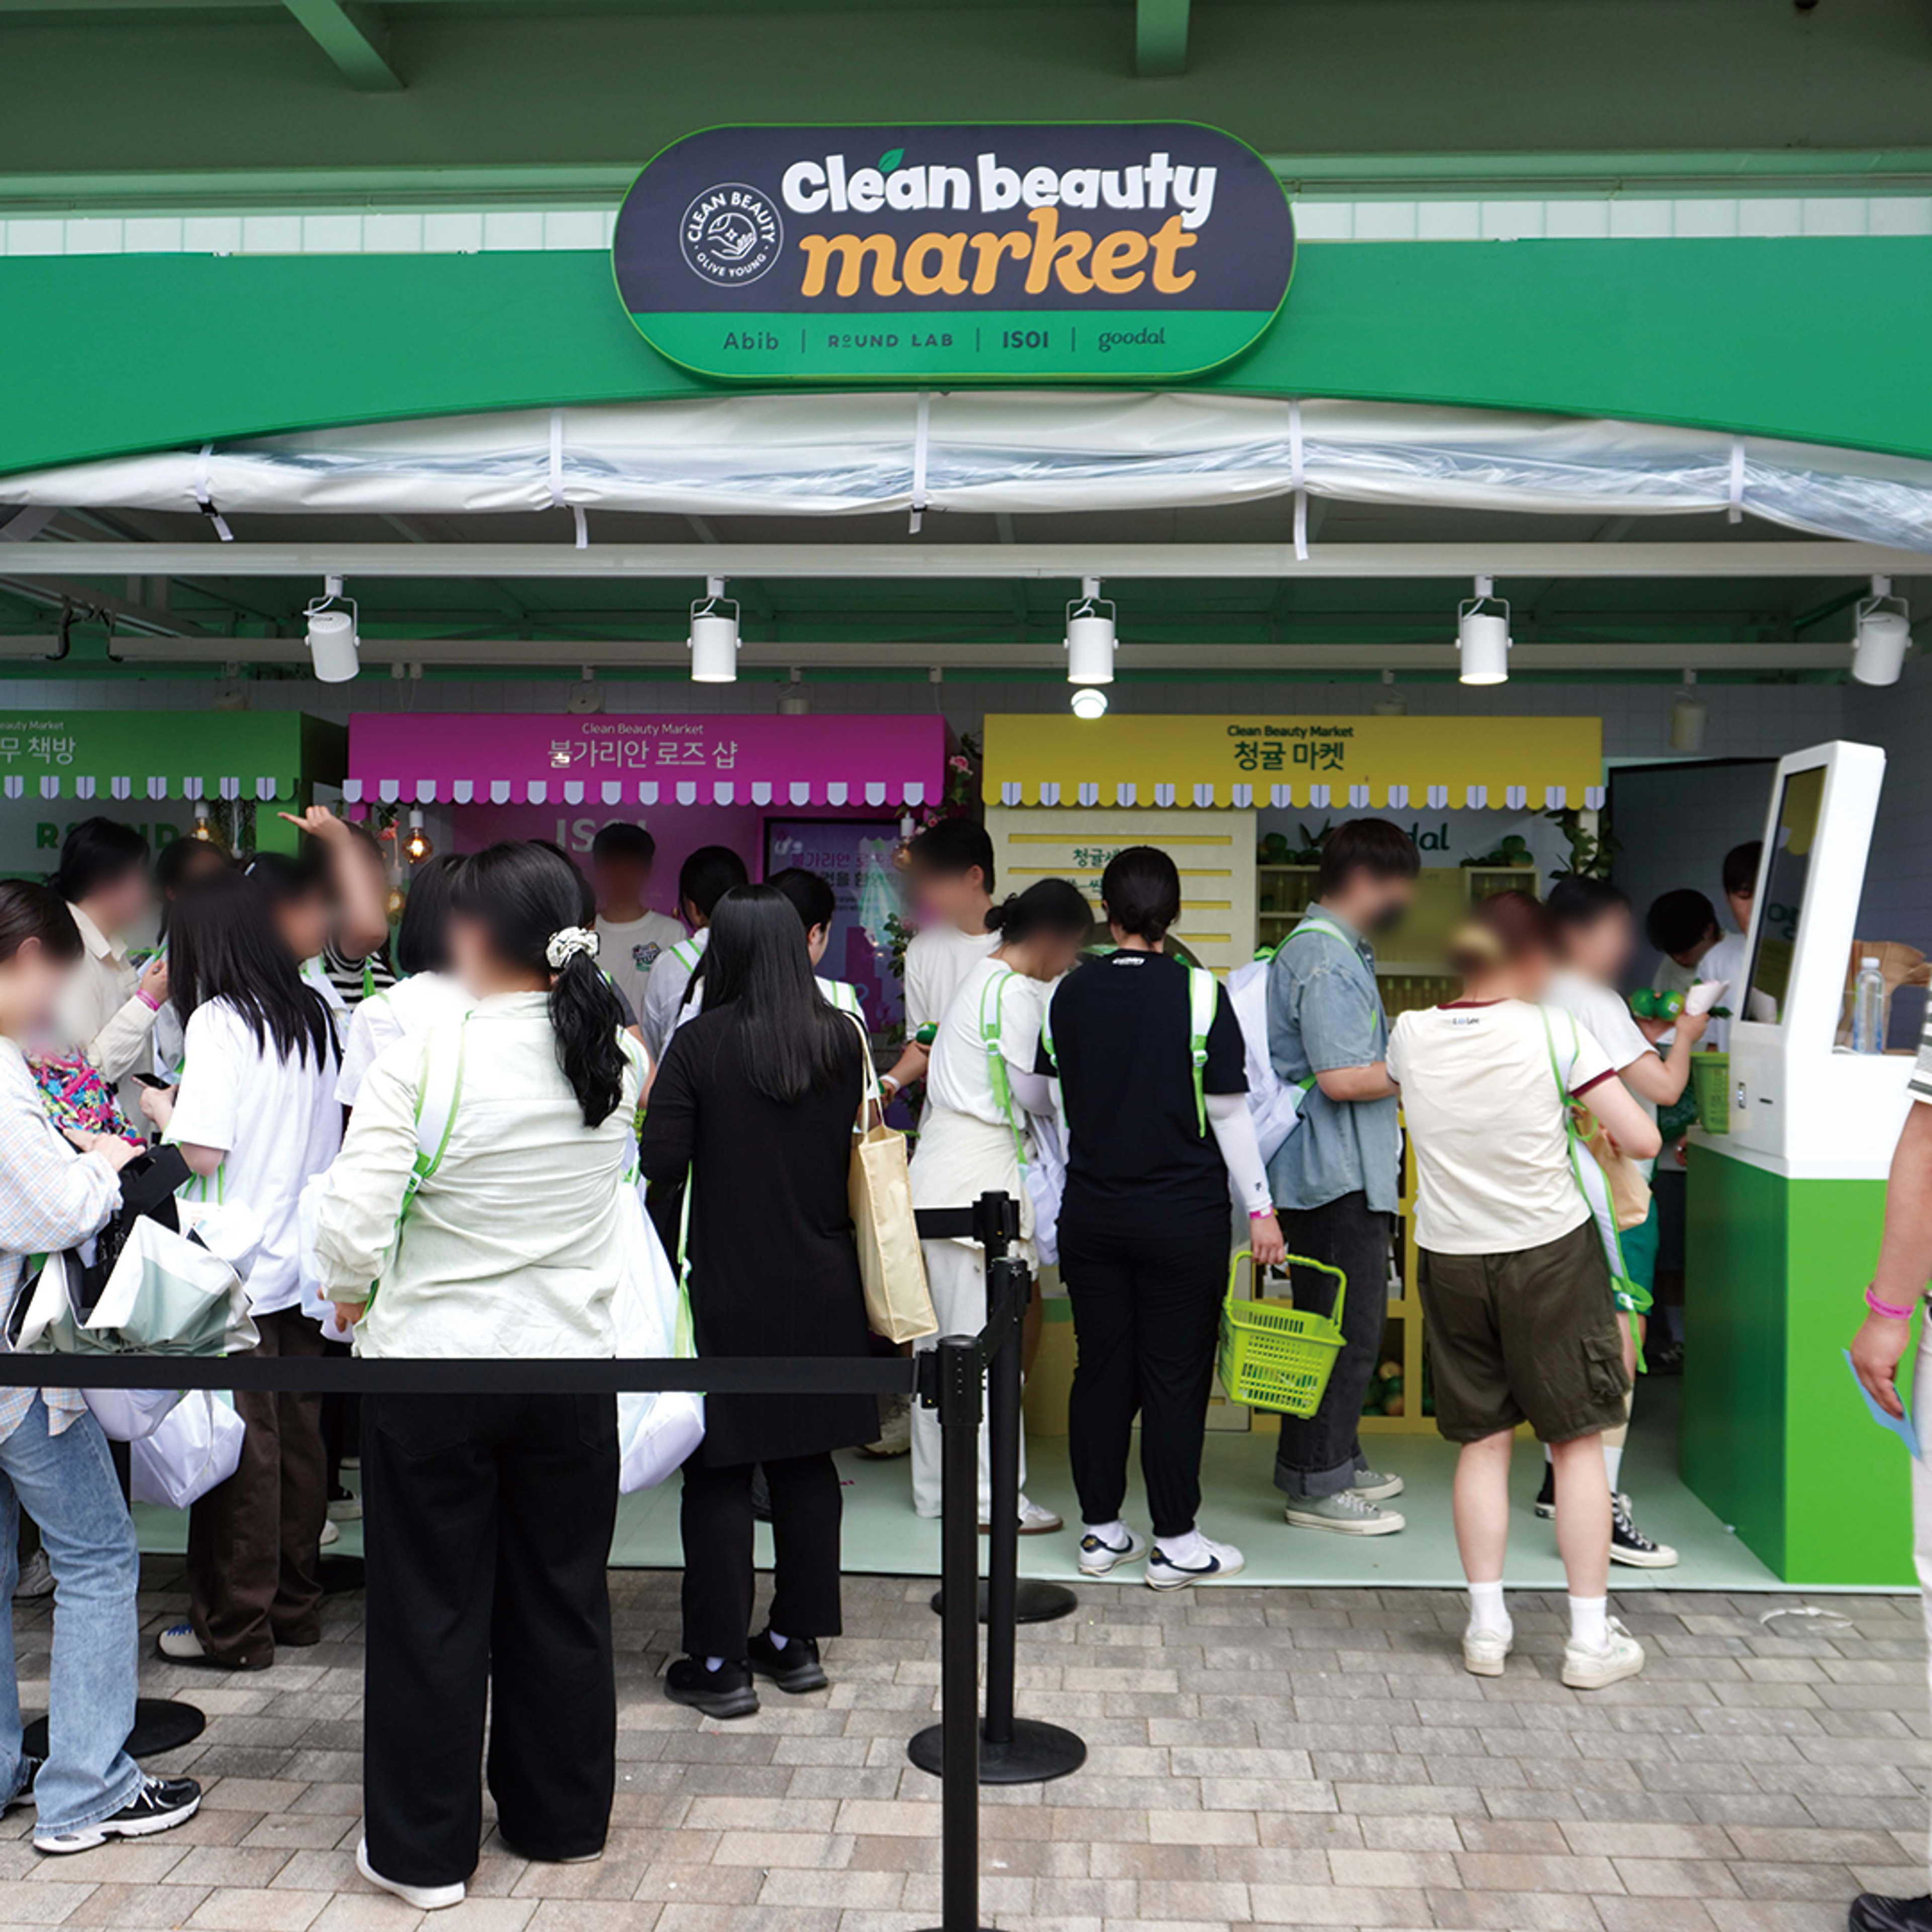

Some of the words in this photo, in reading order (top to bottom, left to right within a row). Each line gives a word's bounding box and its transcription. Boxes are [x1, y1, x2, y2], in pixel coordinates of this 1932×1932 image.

[782, 155, 971, 213] Clean
[977, 152, 1217, 229] beauty
[687, 193, 727, 242] CLEAN
[731, 191, 775, 243] BEAUTY
[697, 252, 726, 276] OLIVE
[728, 253, 766, 277] YOUNG
[799, 207, 1197, 297] market
[723, 332, 779, 350] Abib
[911, 334, 953, 347] LAB
[1003, 331, 1049, 349] ISOI
[1098, 327, 1165, 353] goodal
[29, 720, 64, 730] Market
[582, 723, 615, 735] Clean
[618, 723, 659, 736] Beauty
[662, 723, 703, 735] Market
[1227, 725, 1262, 737] Clean
[1264, 725, 1308, 739] Beauty
[1310, 726, 1354, 737] Market
[28, 737, 76, 765] 책방
[548, 740, 650, 768] 불가리안
[655, 742, 706, 765] 로즈
[711, 741, 738, 769] 샵
[1234, 741, 1286, 771] 청귤
[1293, 742, 1344, 771] 마켓
